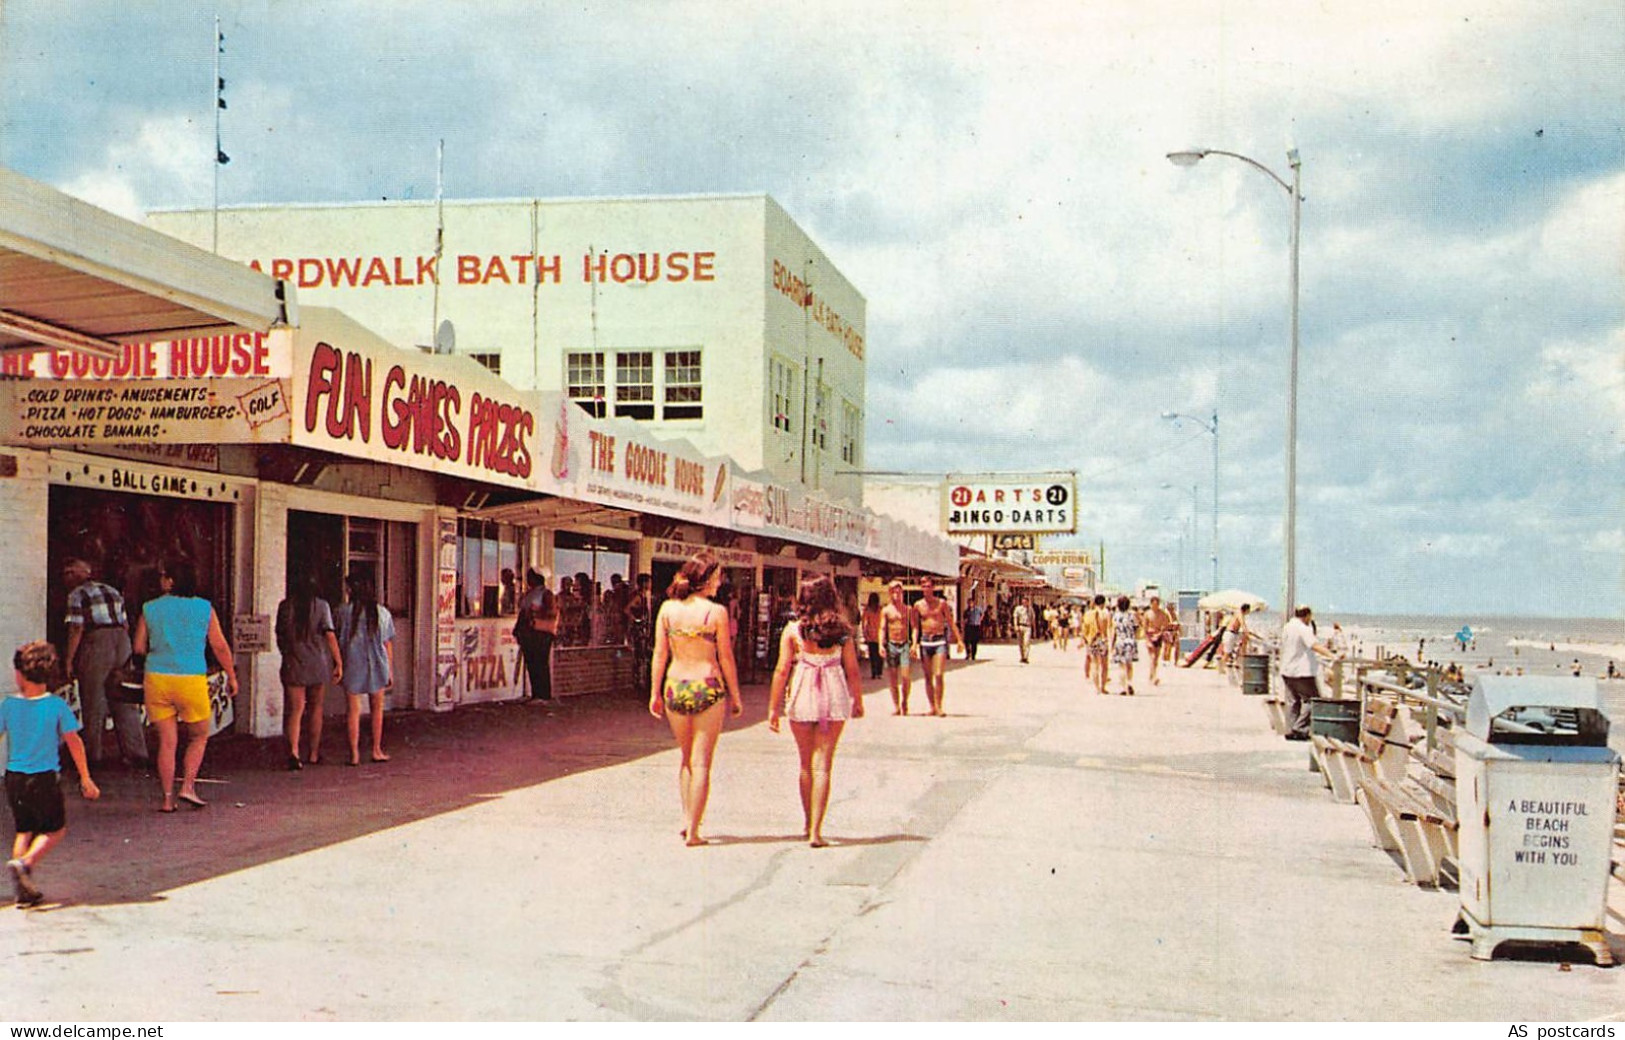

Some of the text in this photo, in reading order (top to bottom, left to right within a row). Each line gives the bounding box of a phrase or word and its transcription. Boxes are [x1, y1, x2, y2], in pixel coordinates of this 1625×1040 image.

[457, 254, 562, 285] BATH
[583, 252, 716, 283] HOUSE
[50, 342, 157, 378] GOODIE
[168, 331, 270, 378] HOUSE
[249, 391, 280, 416] GOLF
[305, 341, 534, 480] FUN GAMES PRIZES
[588, 429, 705, 496] THE GOODIE HOUSE
[111, 468, 188, 495] BALL GAME
[766, 484, 789, 526] SUN
[953, 509, 1067, 524] BINGO DARTS
[466, 653, 508, 693] PIZZA
[1508, 799, 1590, 817] A BEAUTIFUL
[1526, 817, 1569, 832] BEACH
[1523, 834, 1570, 849] BEGINS
[1514, 850, 1578, 866] WITH YOU
